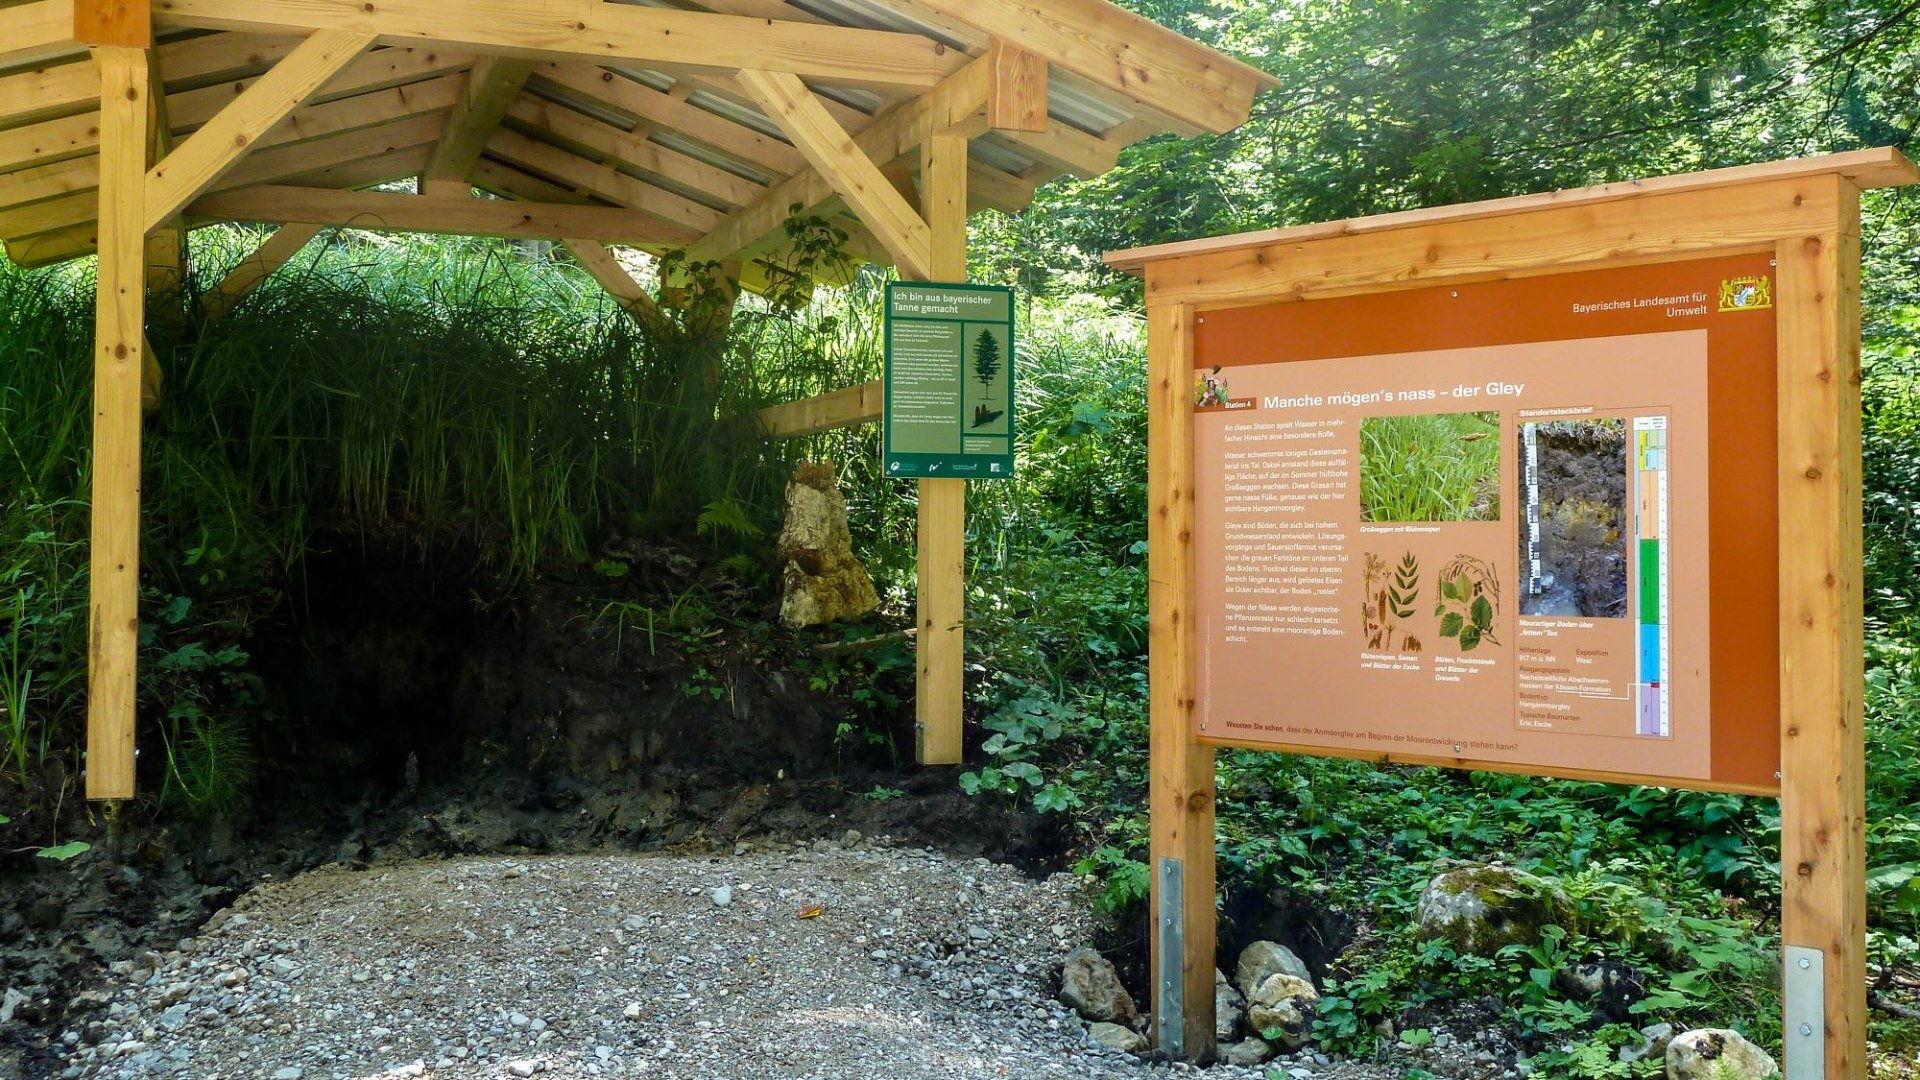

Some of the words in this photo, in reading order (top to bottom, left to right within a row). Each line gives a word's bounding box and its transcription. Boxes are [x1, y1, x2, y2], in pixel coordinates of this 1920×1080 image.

[894, 292, 907, 300] Ich
[910, 293, 923, 301] bin
[925, 295, 940, 303] aus
[943, 294, 992, 305] bayerischer
[1573, 301, 1631, 314] Bayerisches
[1634, 294, 1689, 307] Landesamt
[1692, 293, 1707, 303] für
[894, 303, 919, 312] Tanne
[921, 304, 958, 314] gemacht
[1667, 306, 1707, 317] Umwelt
[1264, 396, 1323, 409] Manche
[1399, 389, 1436, 401] nass
[1453, 385, 1480, 398] der
[1486, 382, 1525, 397] Gley
[1520, 407, 1593, 416] Standortsteckbrief
[1298, 577, 1324, 585] gelöstes
[1225, 603, 1245, 611] Wegen
[1519, 620, 1555, 628] Moorartiger
[1579, 621, 1594, 629] über
[1287, 627, 1321, 636] moorartige
[1520, 666, 1570, 674] Ausgangsgestein
[1520, 701, 1570, 711] Hanganmoorgley
[1520, 712, 1546, 720] Typische
[1546, 713, 1580, 721] Baumarten
[1226, 721, 1252, 729] Wussten
[1368, 732, 1391, 741] Beginn
[1406, 735, 1467, 748] Moorentwicklung
[1496, 742, 1518, 750] kann?
